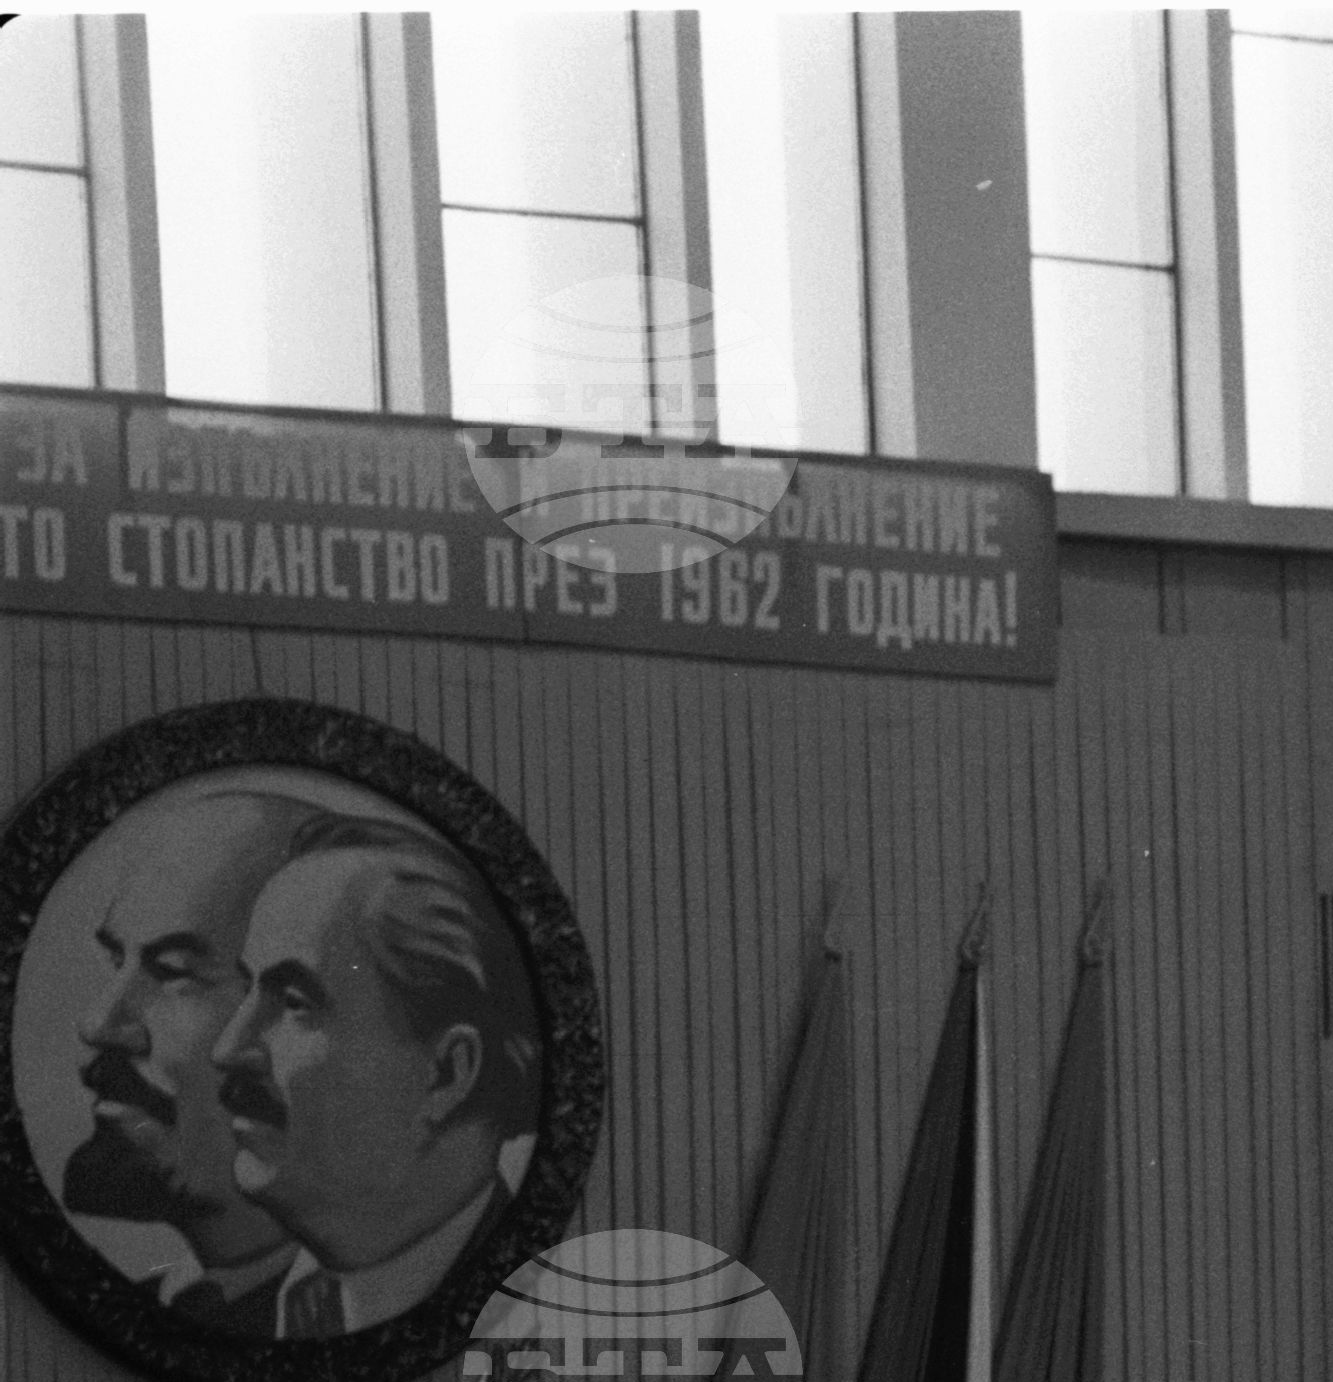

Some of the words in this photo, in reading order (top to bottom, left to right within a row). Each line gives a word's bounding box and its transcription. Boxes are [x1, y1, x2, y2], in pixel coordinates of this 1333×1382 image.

[15, 416, 89, 487] ЗА
[106, 511, 450, 603] СТОПАНСТВО
[484, 536, 617, 618] ПРЕЗ
[660, 541, 782, 631] 1962
[816, 564, 1018, 651] ГОДИНА!
